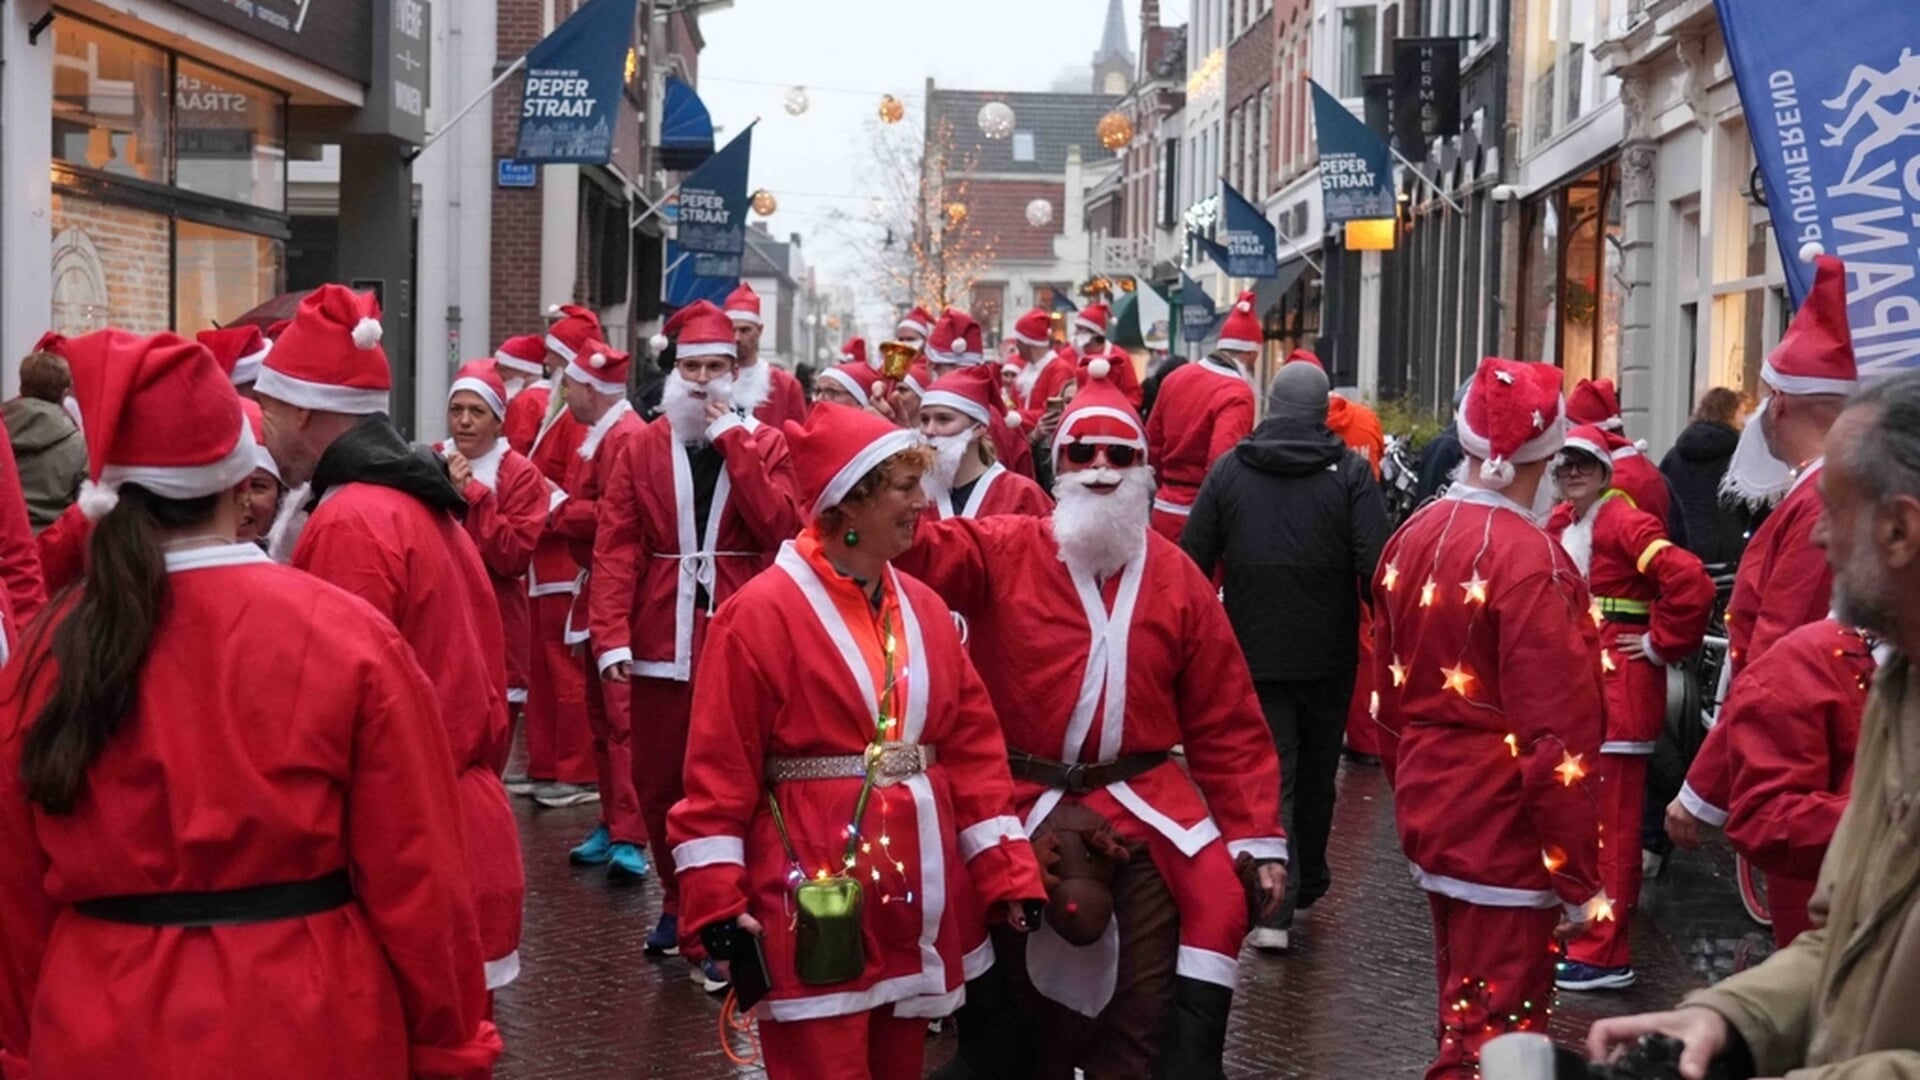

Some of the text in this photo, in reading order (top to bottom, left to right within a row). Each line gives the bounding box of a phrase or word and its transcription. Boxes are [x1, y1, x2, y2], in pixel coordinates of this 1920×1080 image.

[525, 78, 589, 97] PEPER
[523, 98, 597, 117] STRAAT
[1320, 159, 1367, 174] PEPER
[1322, 172, 1376, 190] STRAAT
[681, 195, 724, 209] PEPER
[680, 208, 730, 224] STRAAT
